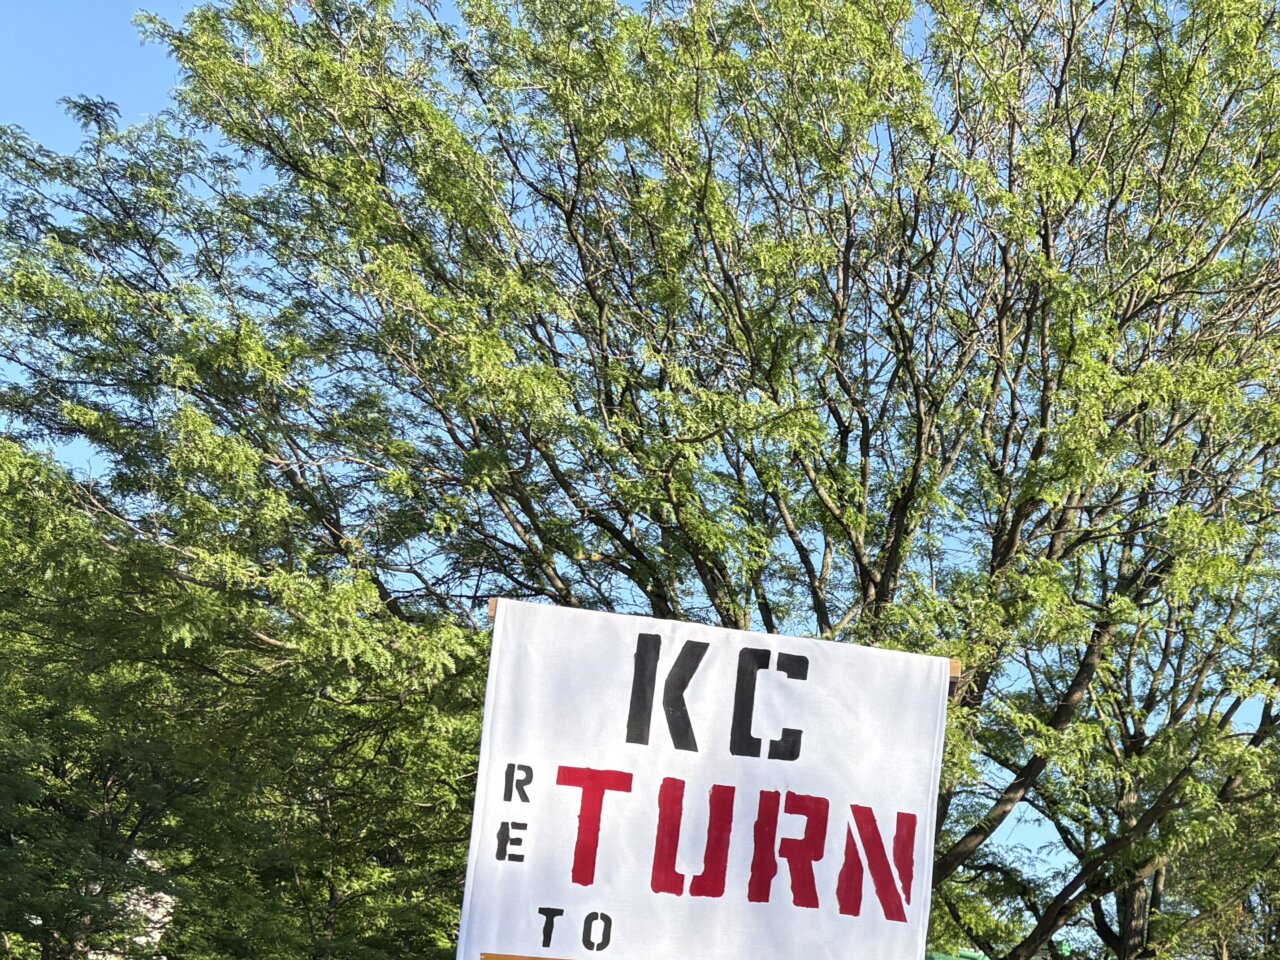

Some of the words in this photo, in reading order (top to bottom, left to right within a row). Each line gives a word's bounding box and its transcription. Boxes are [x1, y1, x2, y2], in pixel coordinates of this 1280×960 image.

[625, 633, 808, 760] KC
[556, 766, 916, 922] TURN
[538, 907, 612, 951] TO
